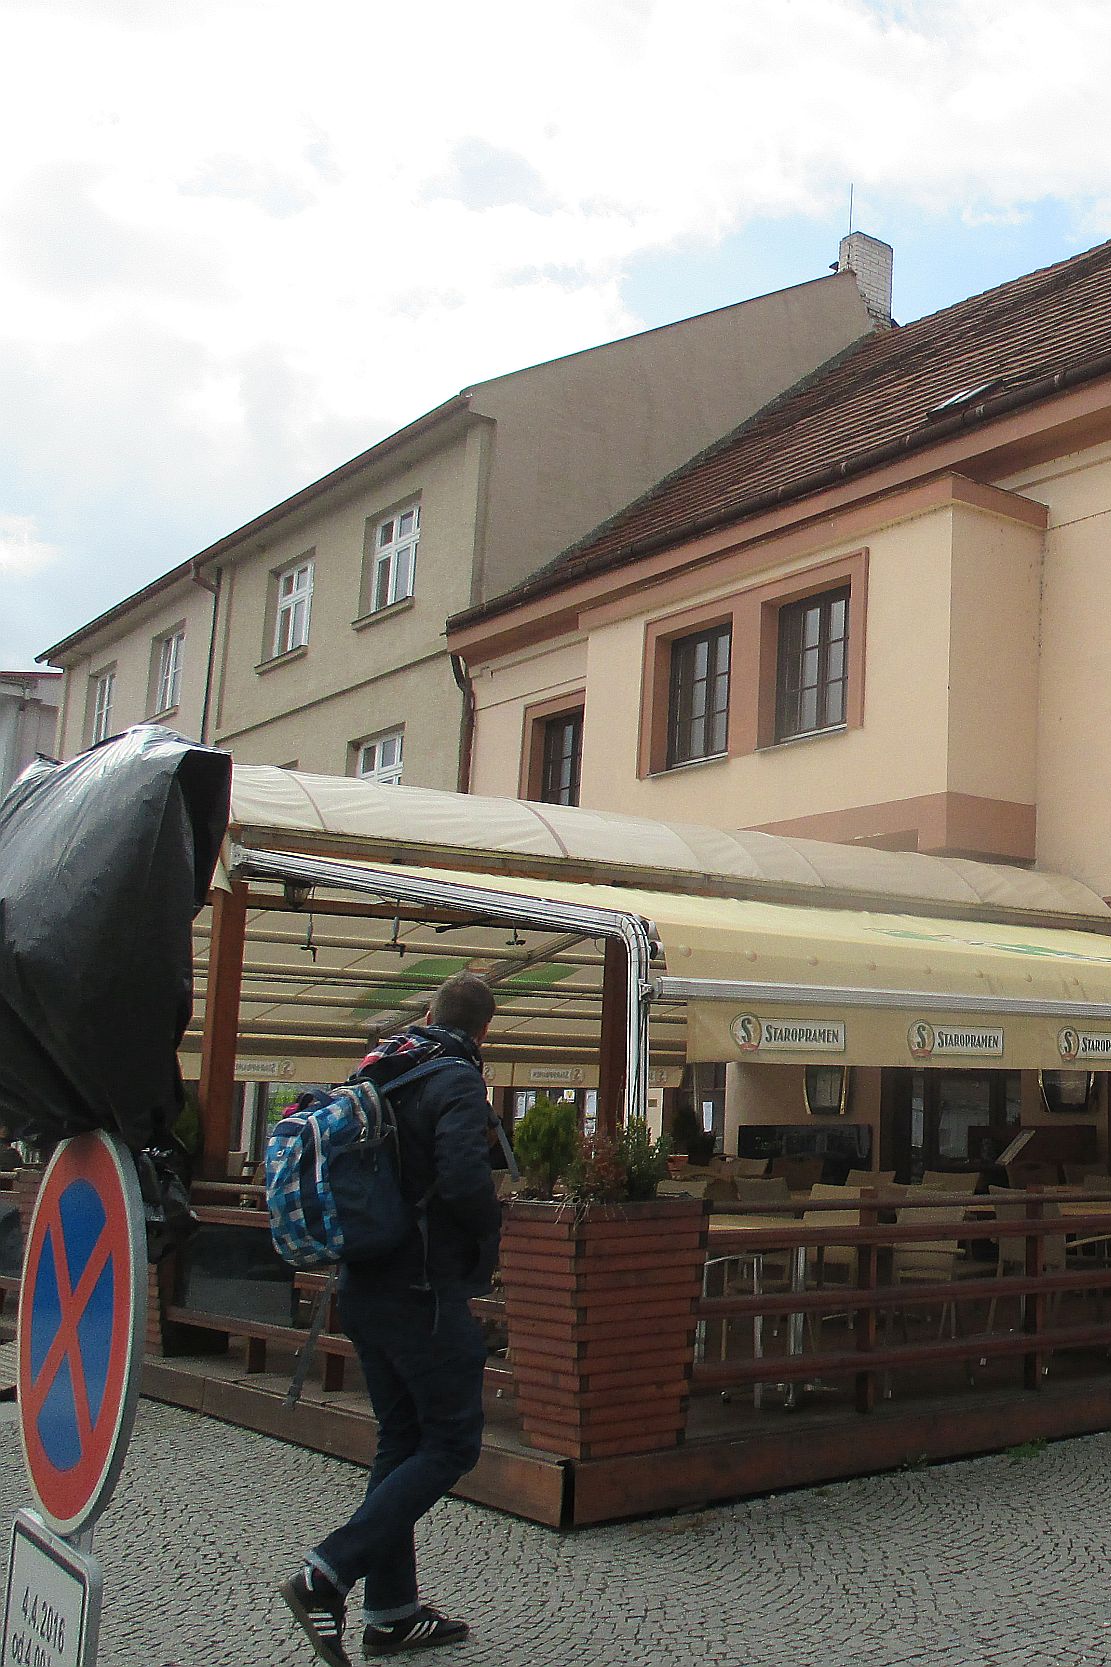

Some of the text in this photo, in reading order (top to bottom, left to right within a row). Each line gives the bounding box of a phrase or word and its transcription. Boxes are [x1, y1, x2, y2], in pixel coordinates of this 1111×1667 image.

[764, 1024, 840, 1044] STAROPRAMEN
[937, 1030, 1000, 1049] STAROPRAMEN
[22, 1586, 66, 1655] 4.4.2016
